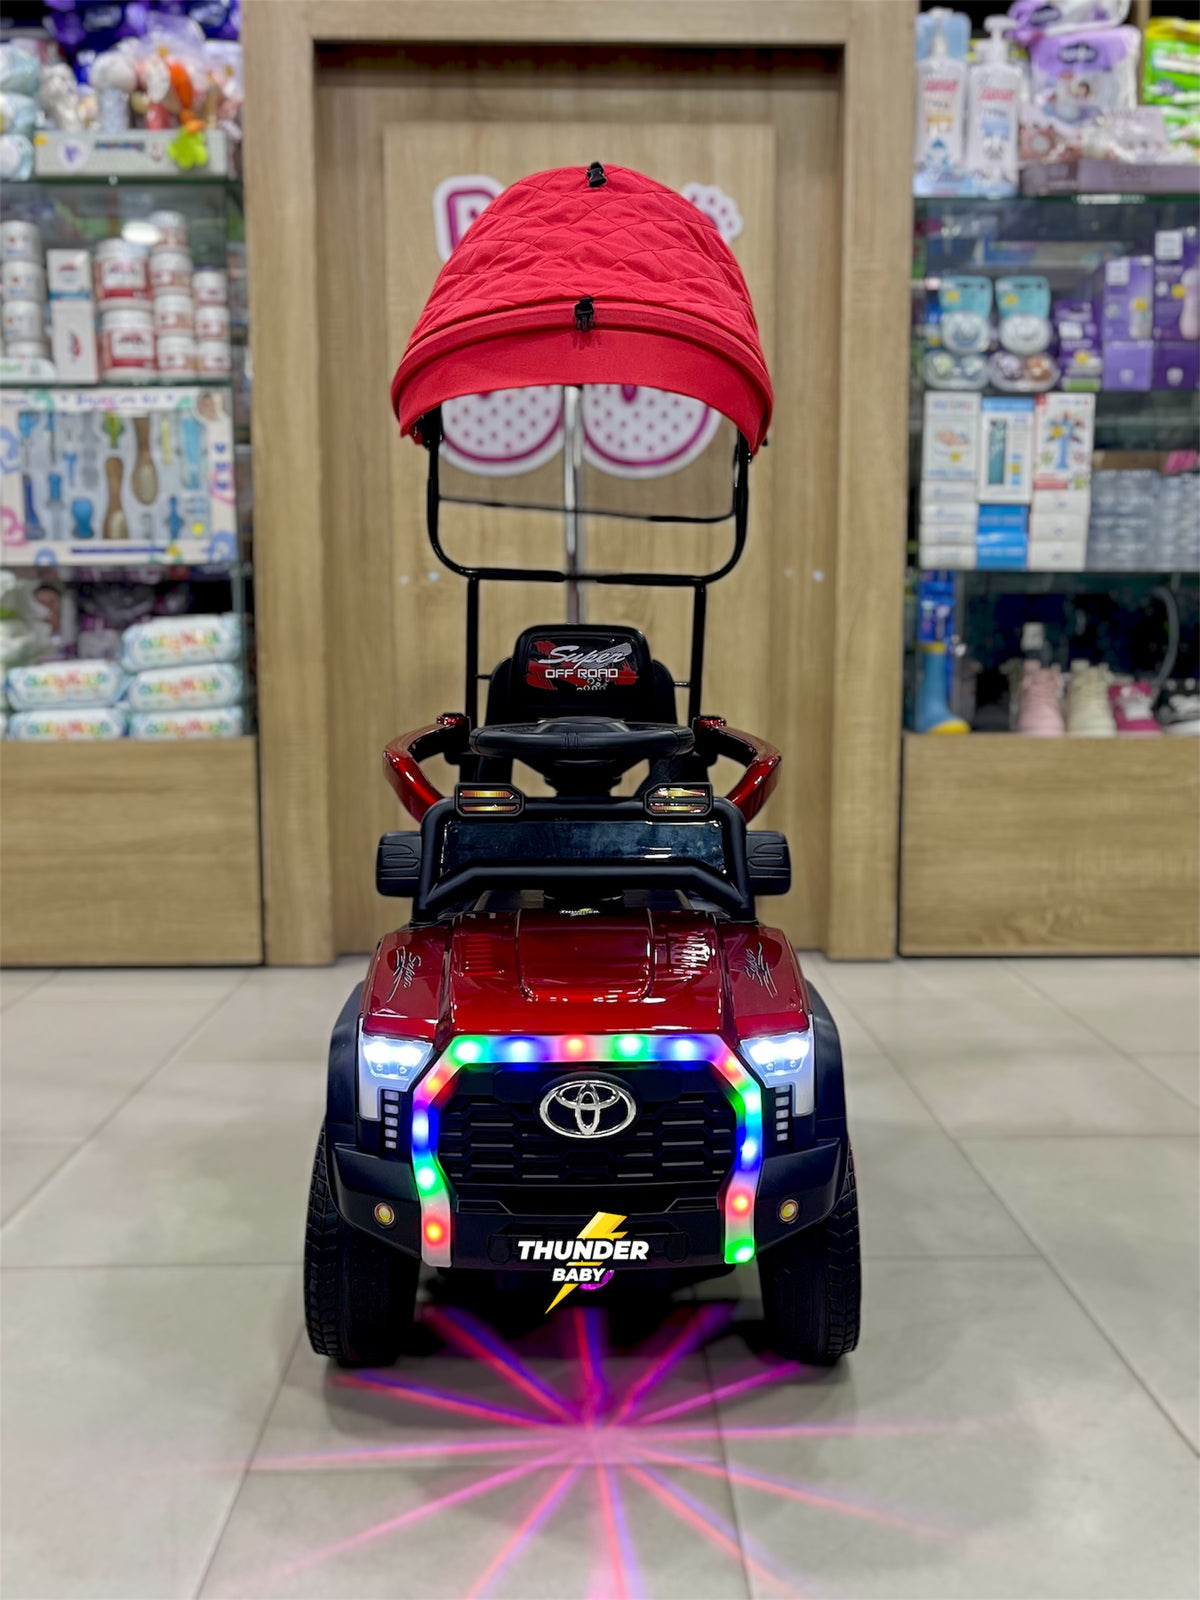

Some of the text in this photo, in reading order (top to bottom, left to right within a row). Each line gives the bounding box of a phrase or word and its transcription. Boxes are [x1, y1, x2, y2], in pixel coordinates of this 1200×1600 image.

[538, 645, 625, 669] Super
[545, 668, 618, 678] OFF ROAD
